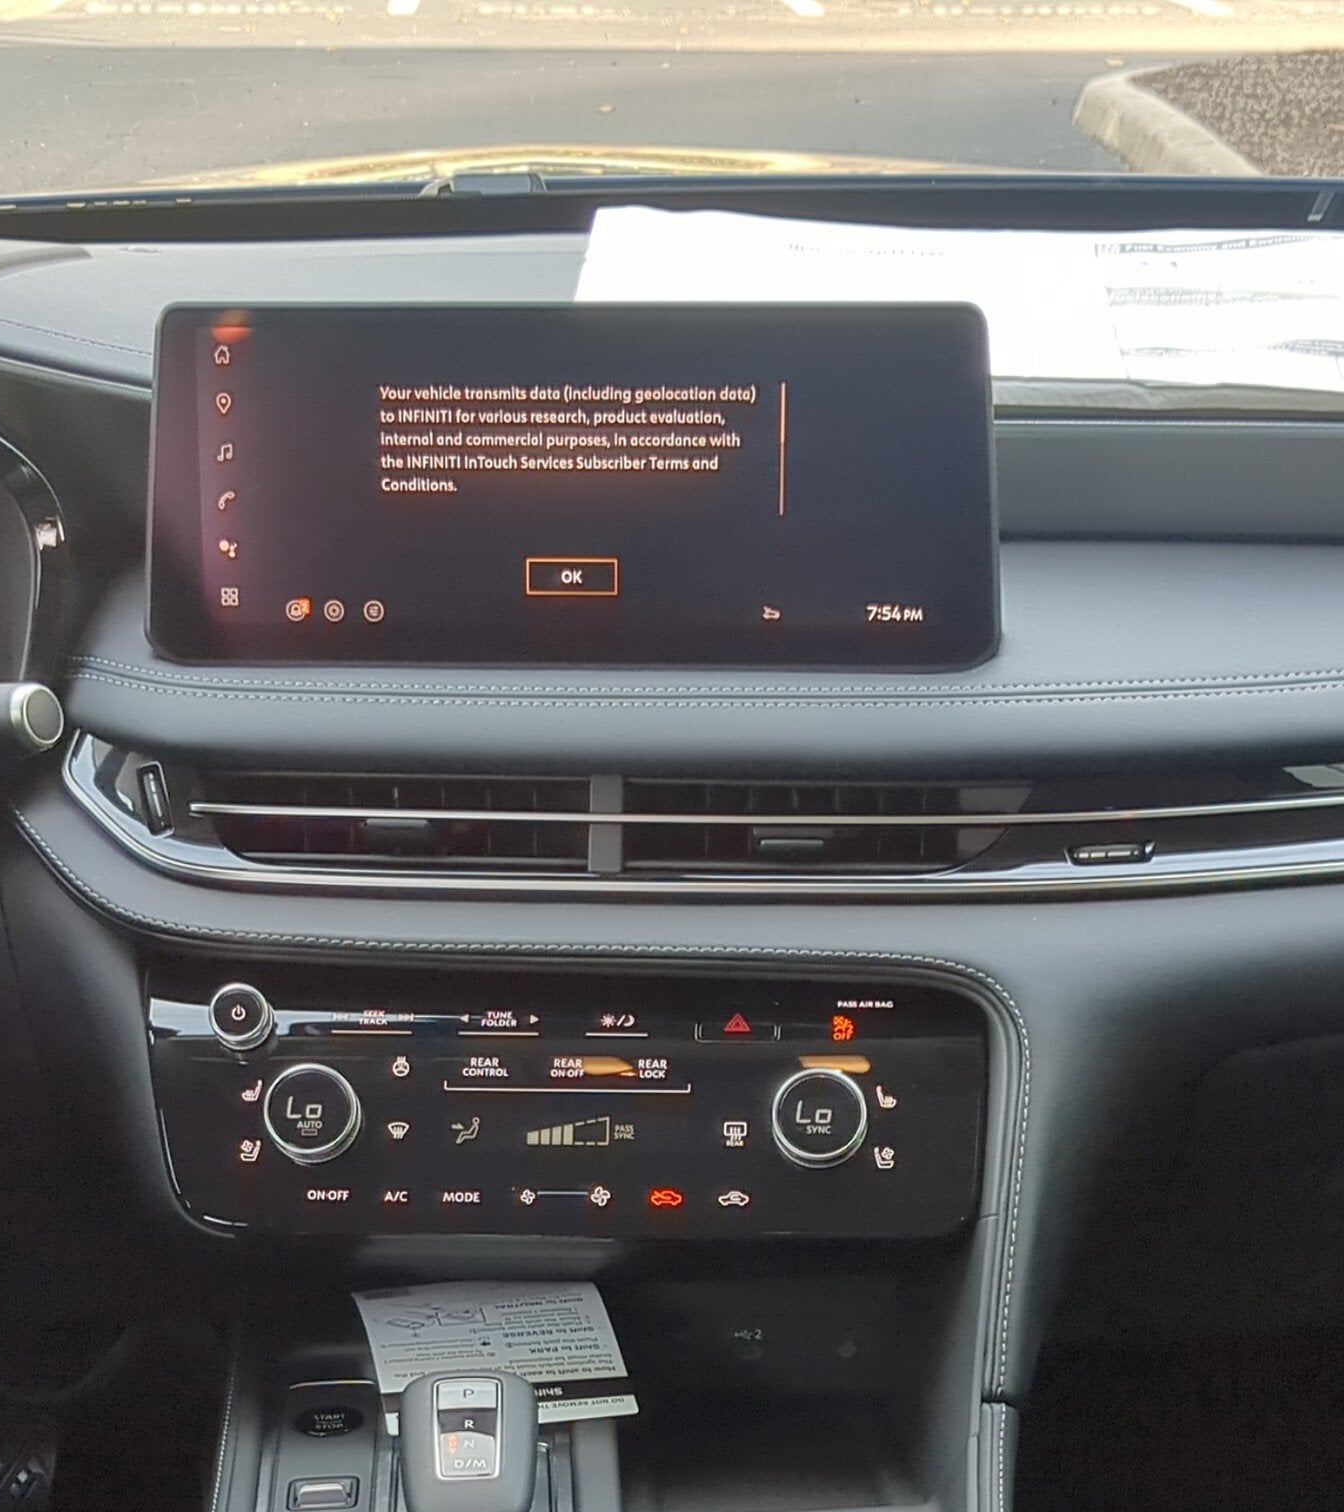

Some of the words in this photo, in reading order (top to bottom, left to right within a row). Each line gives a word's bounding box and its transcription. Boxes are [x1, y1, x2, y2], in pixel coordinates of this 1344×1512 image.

[380, 385, 413, 400] Your
[414, 385, 461, 400] vehicle
[464, 386, 527, 400] transmits
[529, 385, 561, 400] data
[635, 385, 716, 403] geolocation
[719, 384, 757, 403] data)
[380, 410, 395, 424] to
[398, 409, 452, 424] INFINITI
[456, 409, 476, 424] for
[478, 410, 528, 424] various
[530, 409, 590, 426] research,
[593, 410, 647, 427] product
[649, 410, 726, 426] evaluation,
[380, 431, 434, 447] internal
[436, 431, 463, 447] and
[465, 431, 544, 447] commercial
[545, 433, 611, 450] purposes,
[630, 431, 707, 447] accordance
[708, 431, 741, 448] with
[380, 454, 404, 469] the
[406, 455, 461, 470] INFINITI
[464, 454, 518, 470] InTouch
[520, 455, 574, 470] Services
[576, 455, 647, 471] Subscriber
[649, 455, 689, 471] Terms
[691, 454, 719, 471] and
[381, 477, 458, 493] Conditions.
[561, 569, 583, 585] OK
[866, 605, 901, 622] 7:54
[903, 607, 924, 622] PM
[837, 1000, 858, 1009] PASS
[858, 1000, 874, 1009] AIR
[874, 1000, 894, 1009] BAG
[486, 1010, 513, 1020] TUNE
[358, 1017, 389, 1026] TRACK
[480, 1018, 518, 1028] FOLDER
[469, 1057, 500, 1068] REAR
[553, 1057, 584, 1069] REAR
[637, 1058, 668, 1070] REAR
[462, 1067, 509, 1078] CONTROL
[638, 1068, 667, 1079] LOCK
[296, 1120, 323, 1129] AUTO
[613, 1123, 635, 1133] PASS
[805, 1125, 832, 1135] SYNC
[613, 1131, 636, 1141] SYNC
[384, 1190, 409, 1202] A/C
[442, 1191, 481, 1202] MODE
[463, 1388, 475, 1399] P
[464, 1419, 475, 1430] R
[463, 1439, 475, 1449] N
[454, 1458, 487, 1469] D/M
